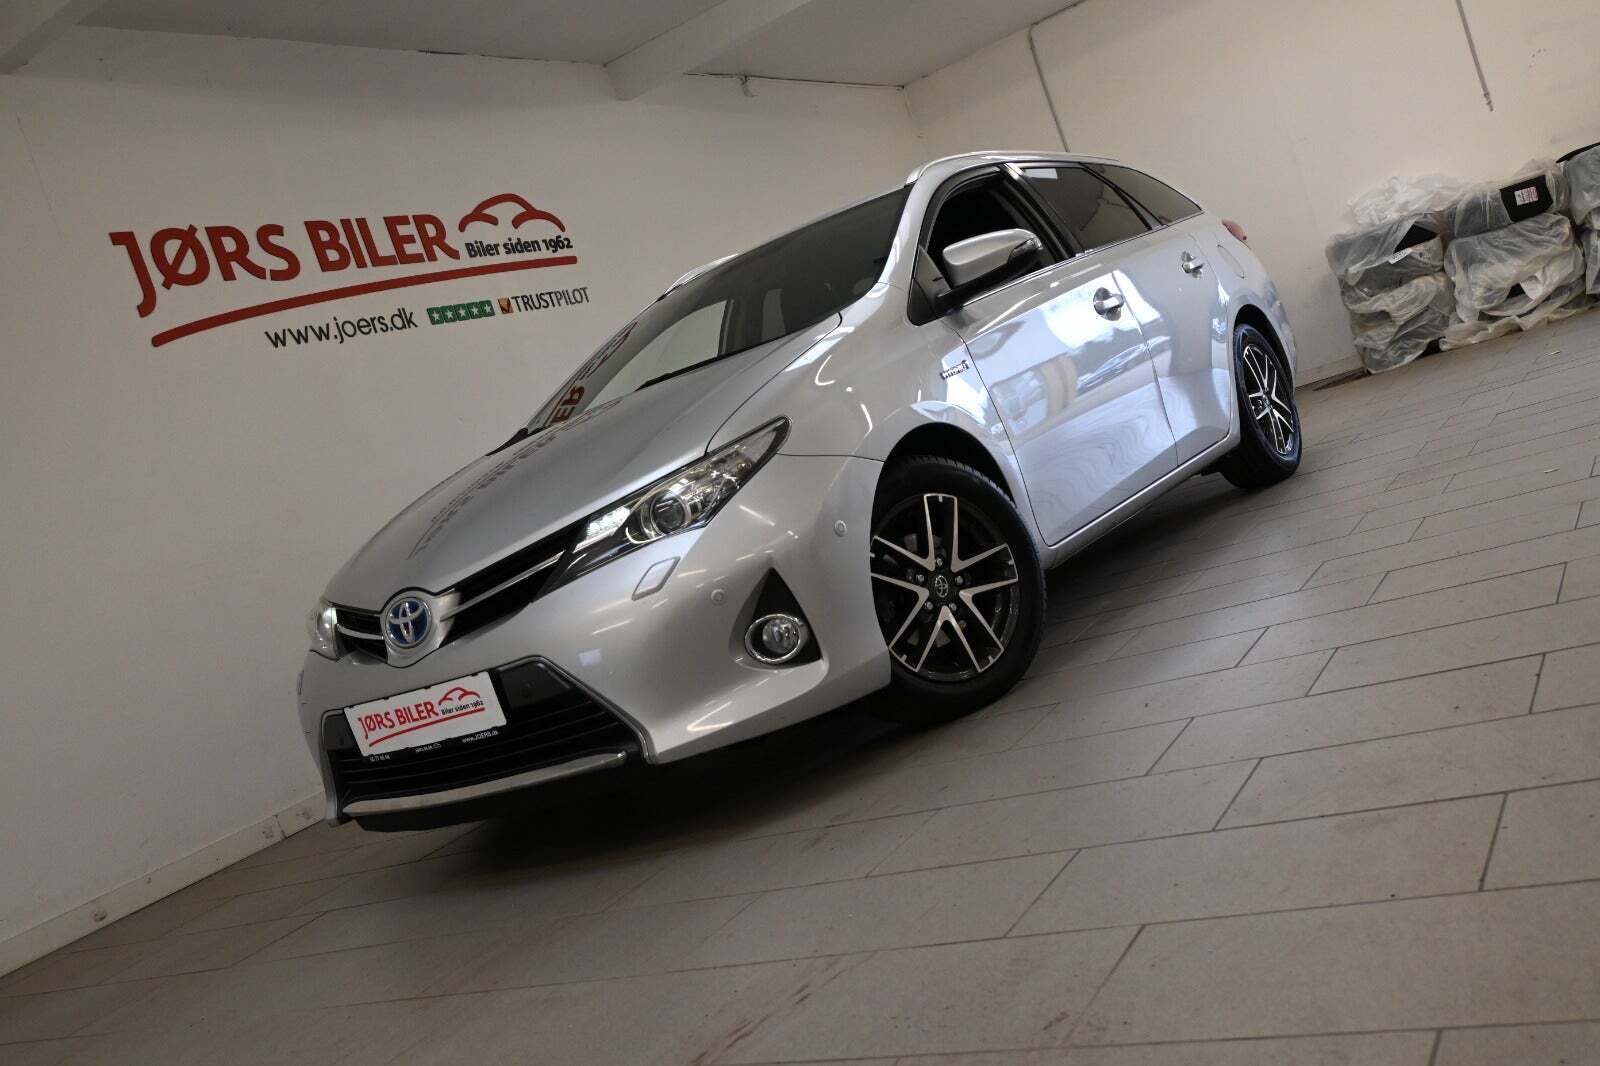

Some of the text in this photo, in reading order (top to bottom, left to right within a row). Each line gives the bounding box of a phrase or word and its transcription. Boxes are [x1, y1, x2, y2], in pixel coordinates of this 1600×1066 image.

[465, 235, 573, 258] Biler siden 1962
[109, 214, 460, 318] JØRS BILER
[511, 287, 590, 313] TRUSTPILOT
[265, 308, 418, 349] www.joers.dk
[358, 701, 439, 739] JØRS BILER
